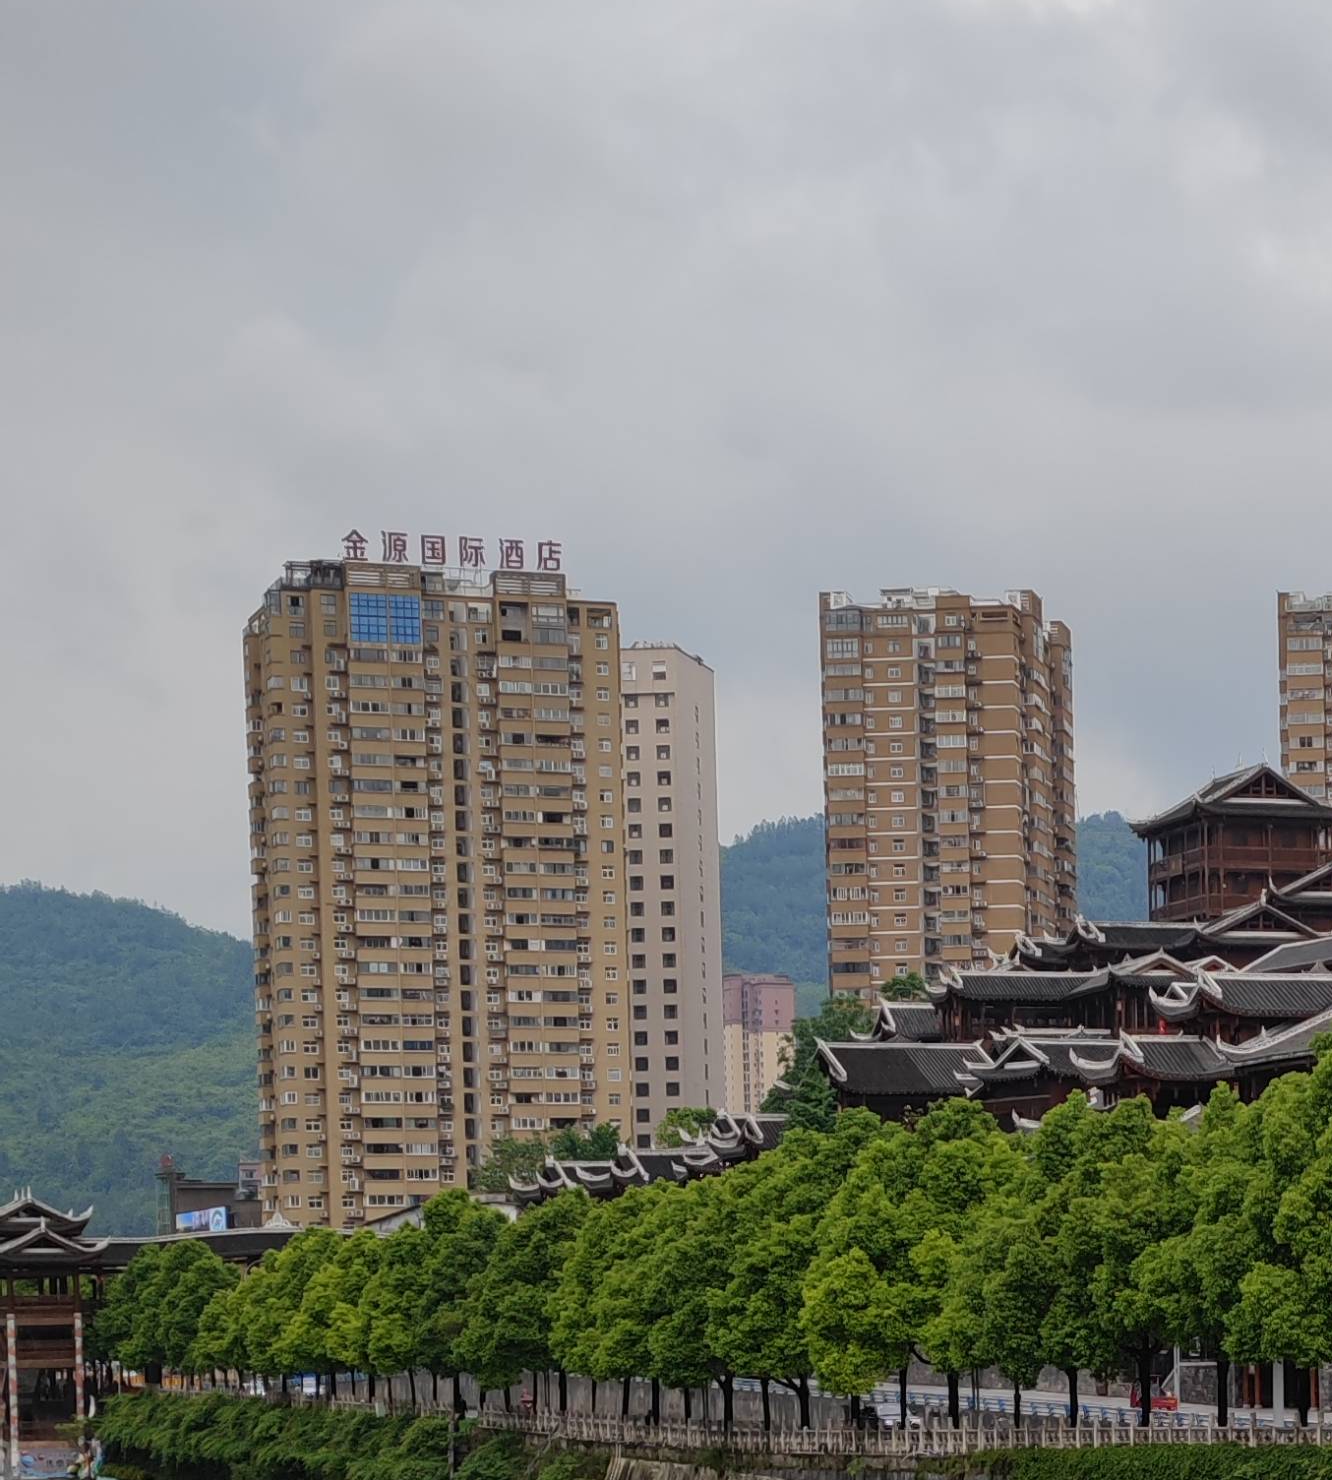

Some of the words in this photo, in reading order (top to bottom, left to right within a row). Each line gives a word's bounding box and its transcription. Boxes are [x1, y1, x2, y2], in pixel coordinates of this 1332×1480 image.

[340, 528, 563, 571] 金源国际酒店
